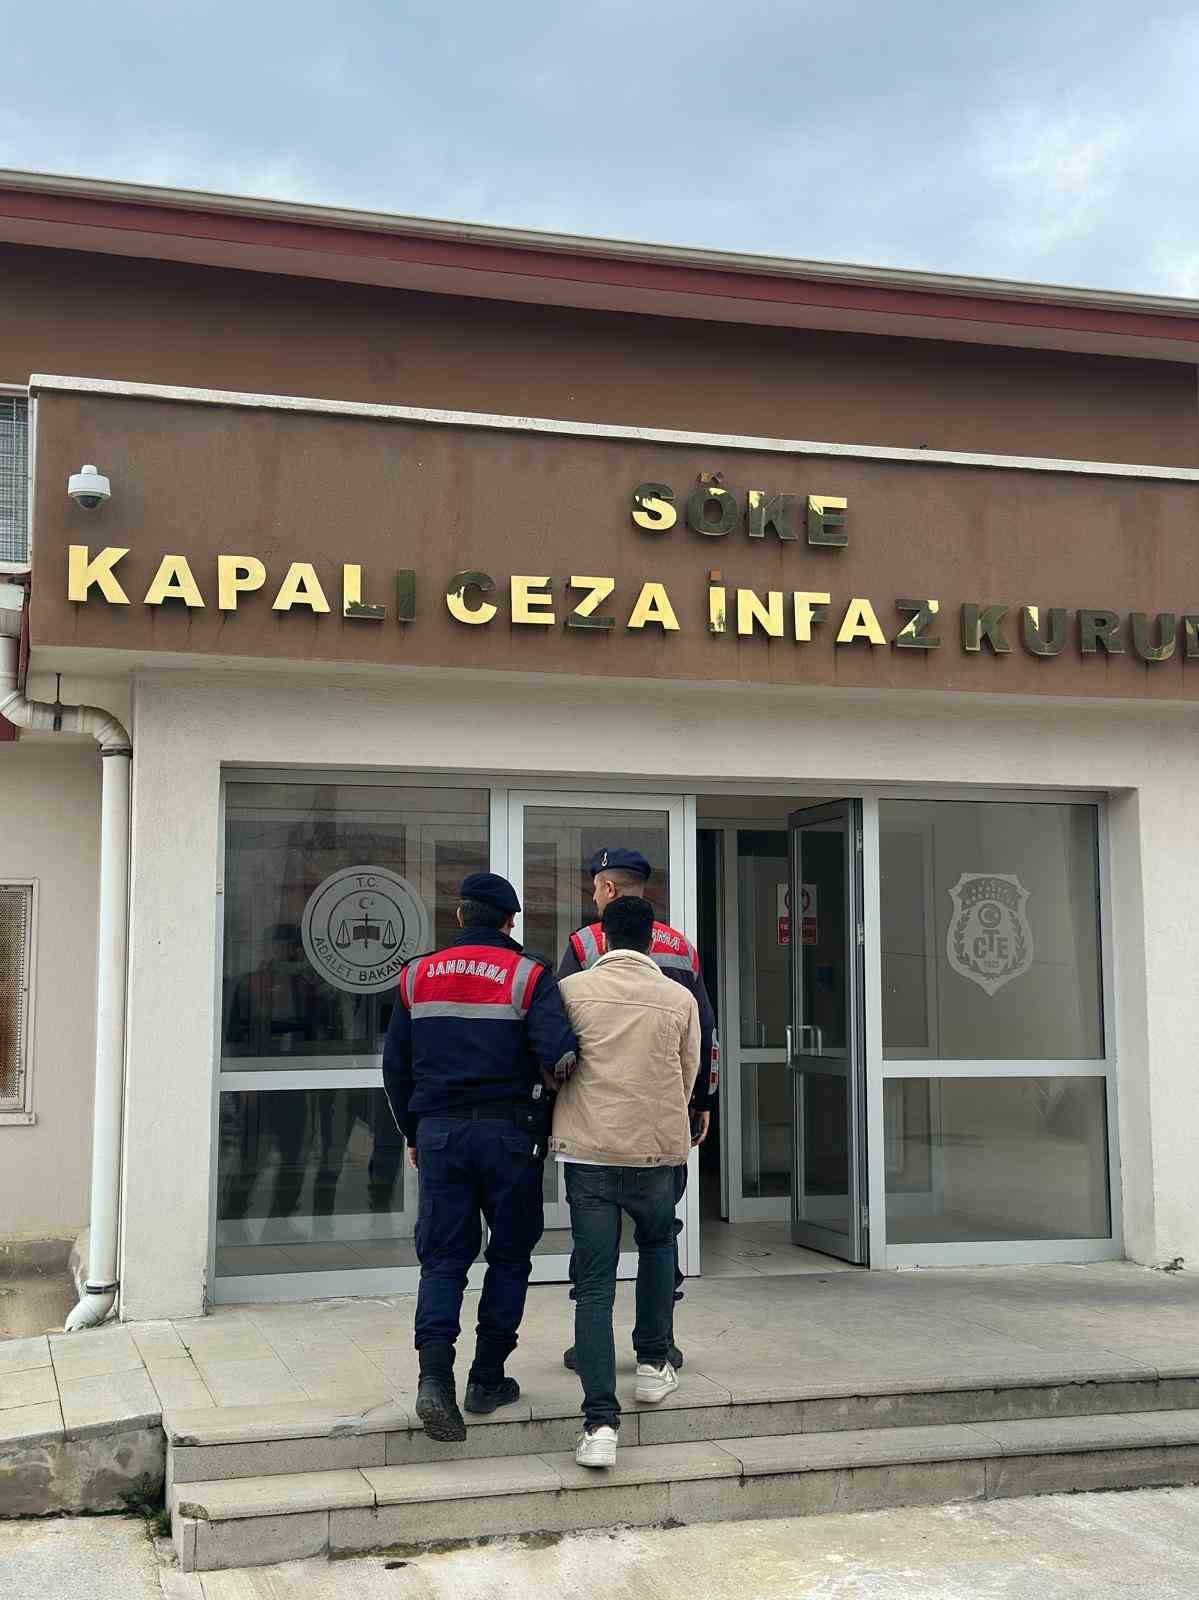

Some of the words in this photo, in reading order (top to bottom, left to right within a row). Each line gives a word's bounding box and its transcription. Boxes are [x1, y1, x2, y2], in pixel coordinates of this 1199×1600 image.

[631, 472, 849, 547] SÖKE
[67, 544, 417, 622] KAPALI
[446, 569, 681, 631] CEZA
[709, 569, 942, 649] İNFAZ
[314, 937, 354, 978] ADALET
[972, 929, 1009, 959] CTE
[426, 959, 508, 985] JANDARMA
